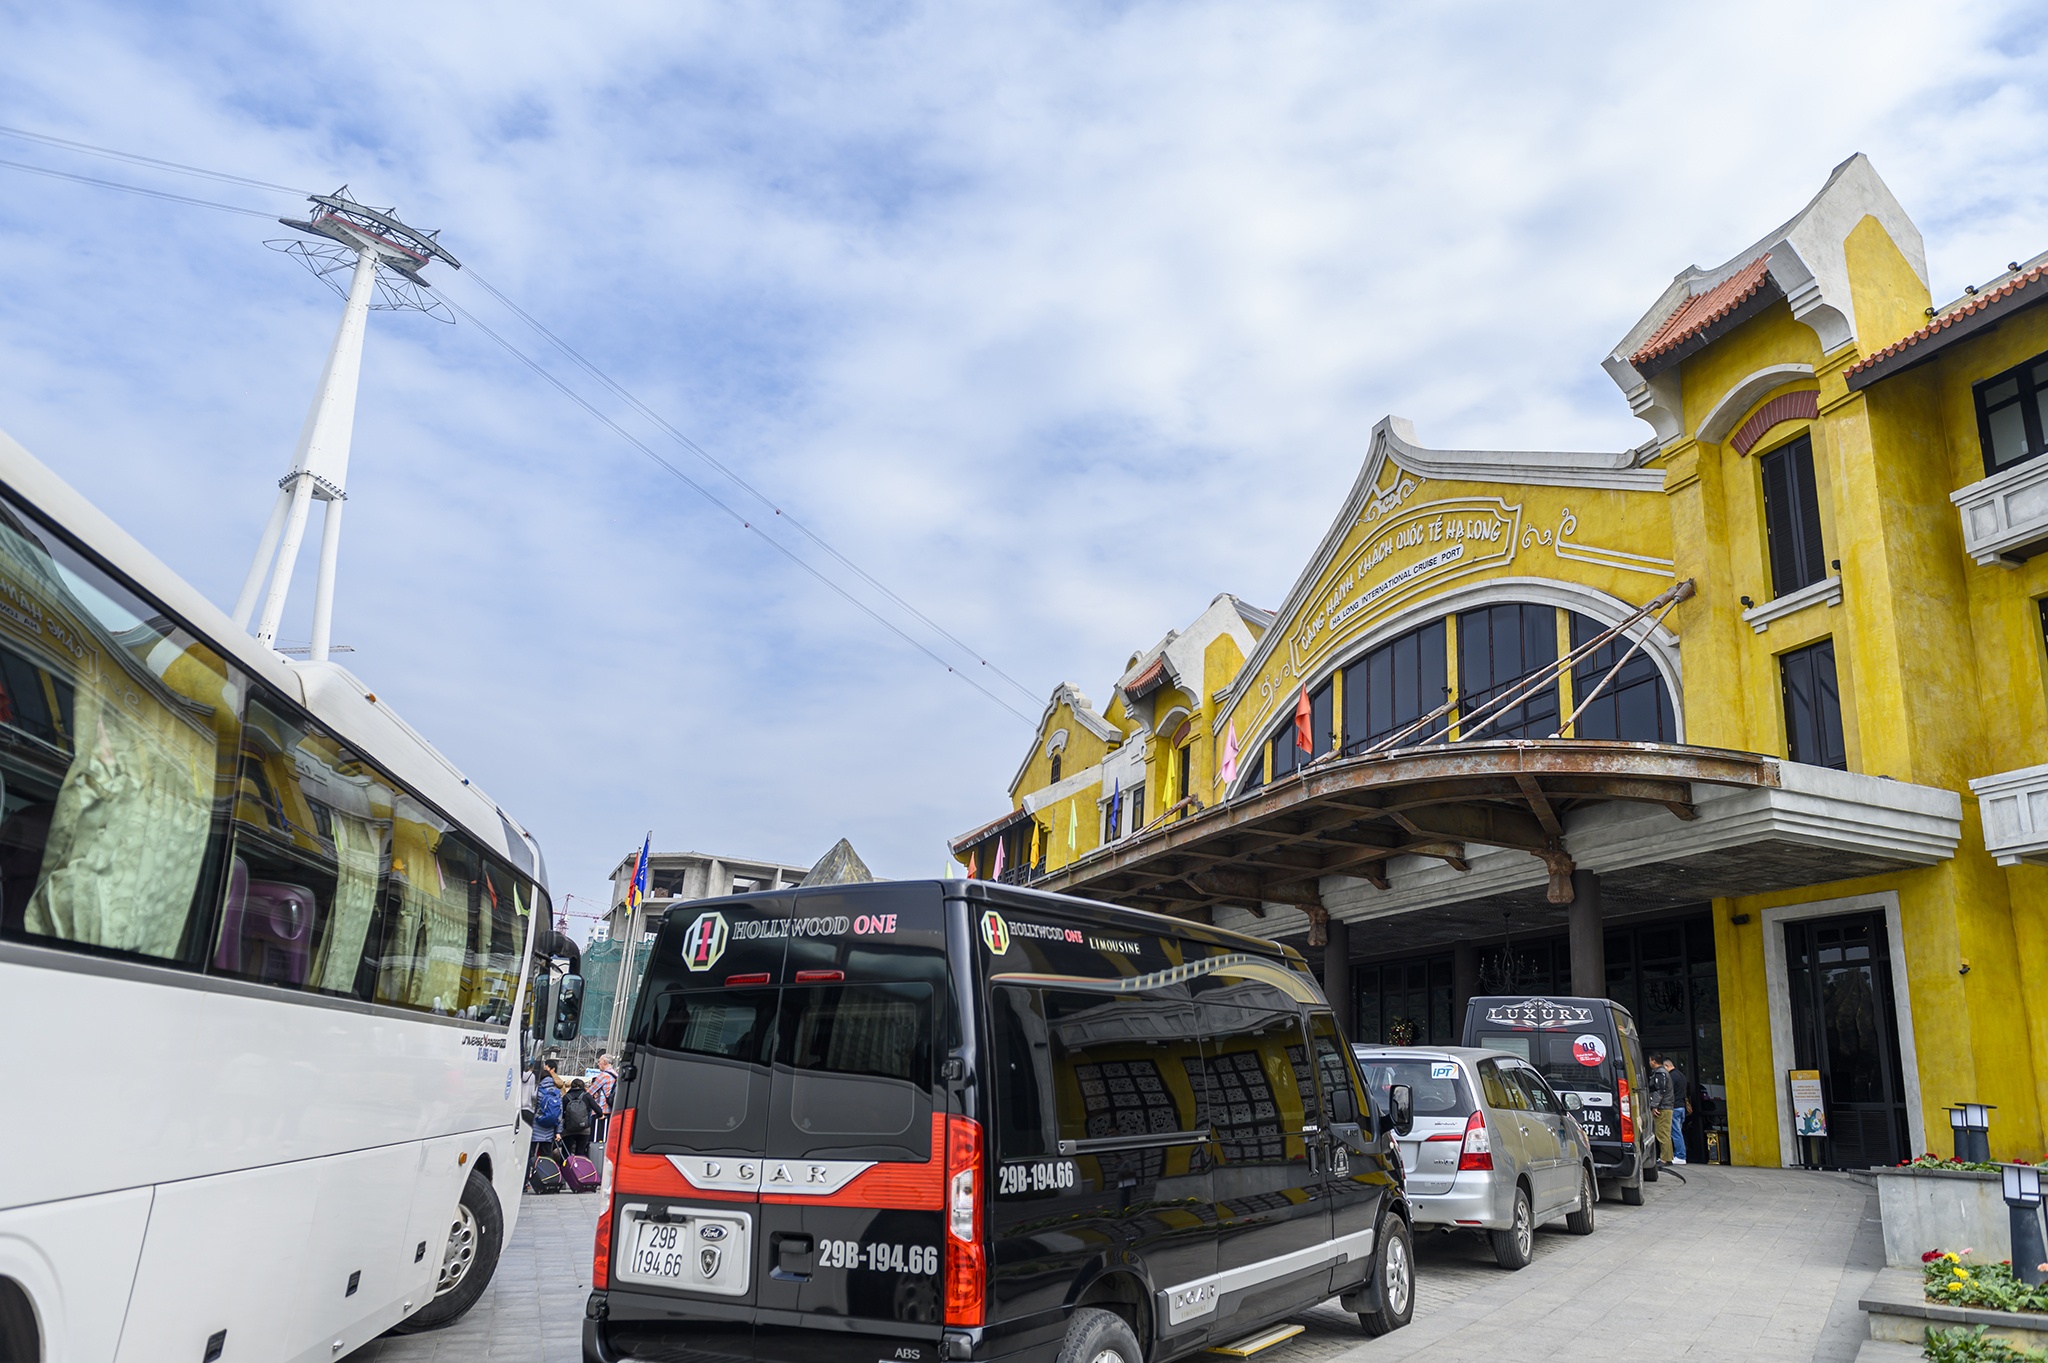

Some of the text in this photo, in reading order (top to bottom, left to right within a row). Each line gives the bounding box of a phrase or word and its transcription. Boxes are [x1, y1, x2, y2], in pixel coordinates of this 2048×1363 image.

[1358, 536, 1393, 580] KHÁCH
[1396, 522, 1424, 550] QUỐC
[1428, 514, 1443, 542] TẾ
[1446, 519, 1464, 543] HẠ
[1466, 518, 1501, 542] LONG
[1332, 547, 1461, 626] HA LONG INTERNATIONAL CRUISE PORT
[732, 914, 897, 941] HOLLYWOOD ONE
[1008, 921, 1141, 955] HOLLYWOOD ONE LIMOUSINE
[1490, 1008, 1588, 1020] LUXURY
[1582, 1041, 1596, 1052] 09
[1582, 1110, 1602, 1122] 14B
[1579, 1124, 1611, 1137] 37.54
[999, 1161, 1074, 1195] 29B-194.66
[649, 1225, 678, 1250] 29B
[702, 1228, 720, 1239] Ford
[637, 1249, 682, 1277] 194.66
[818, 1239, 938, 1275] 29B-194.66
[894, 1348, 920, 1360] ABS
